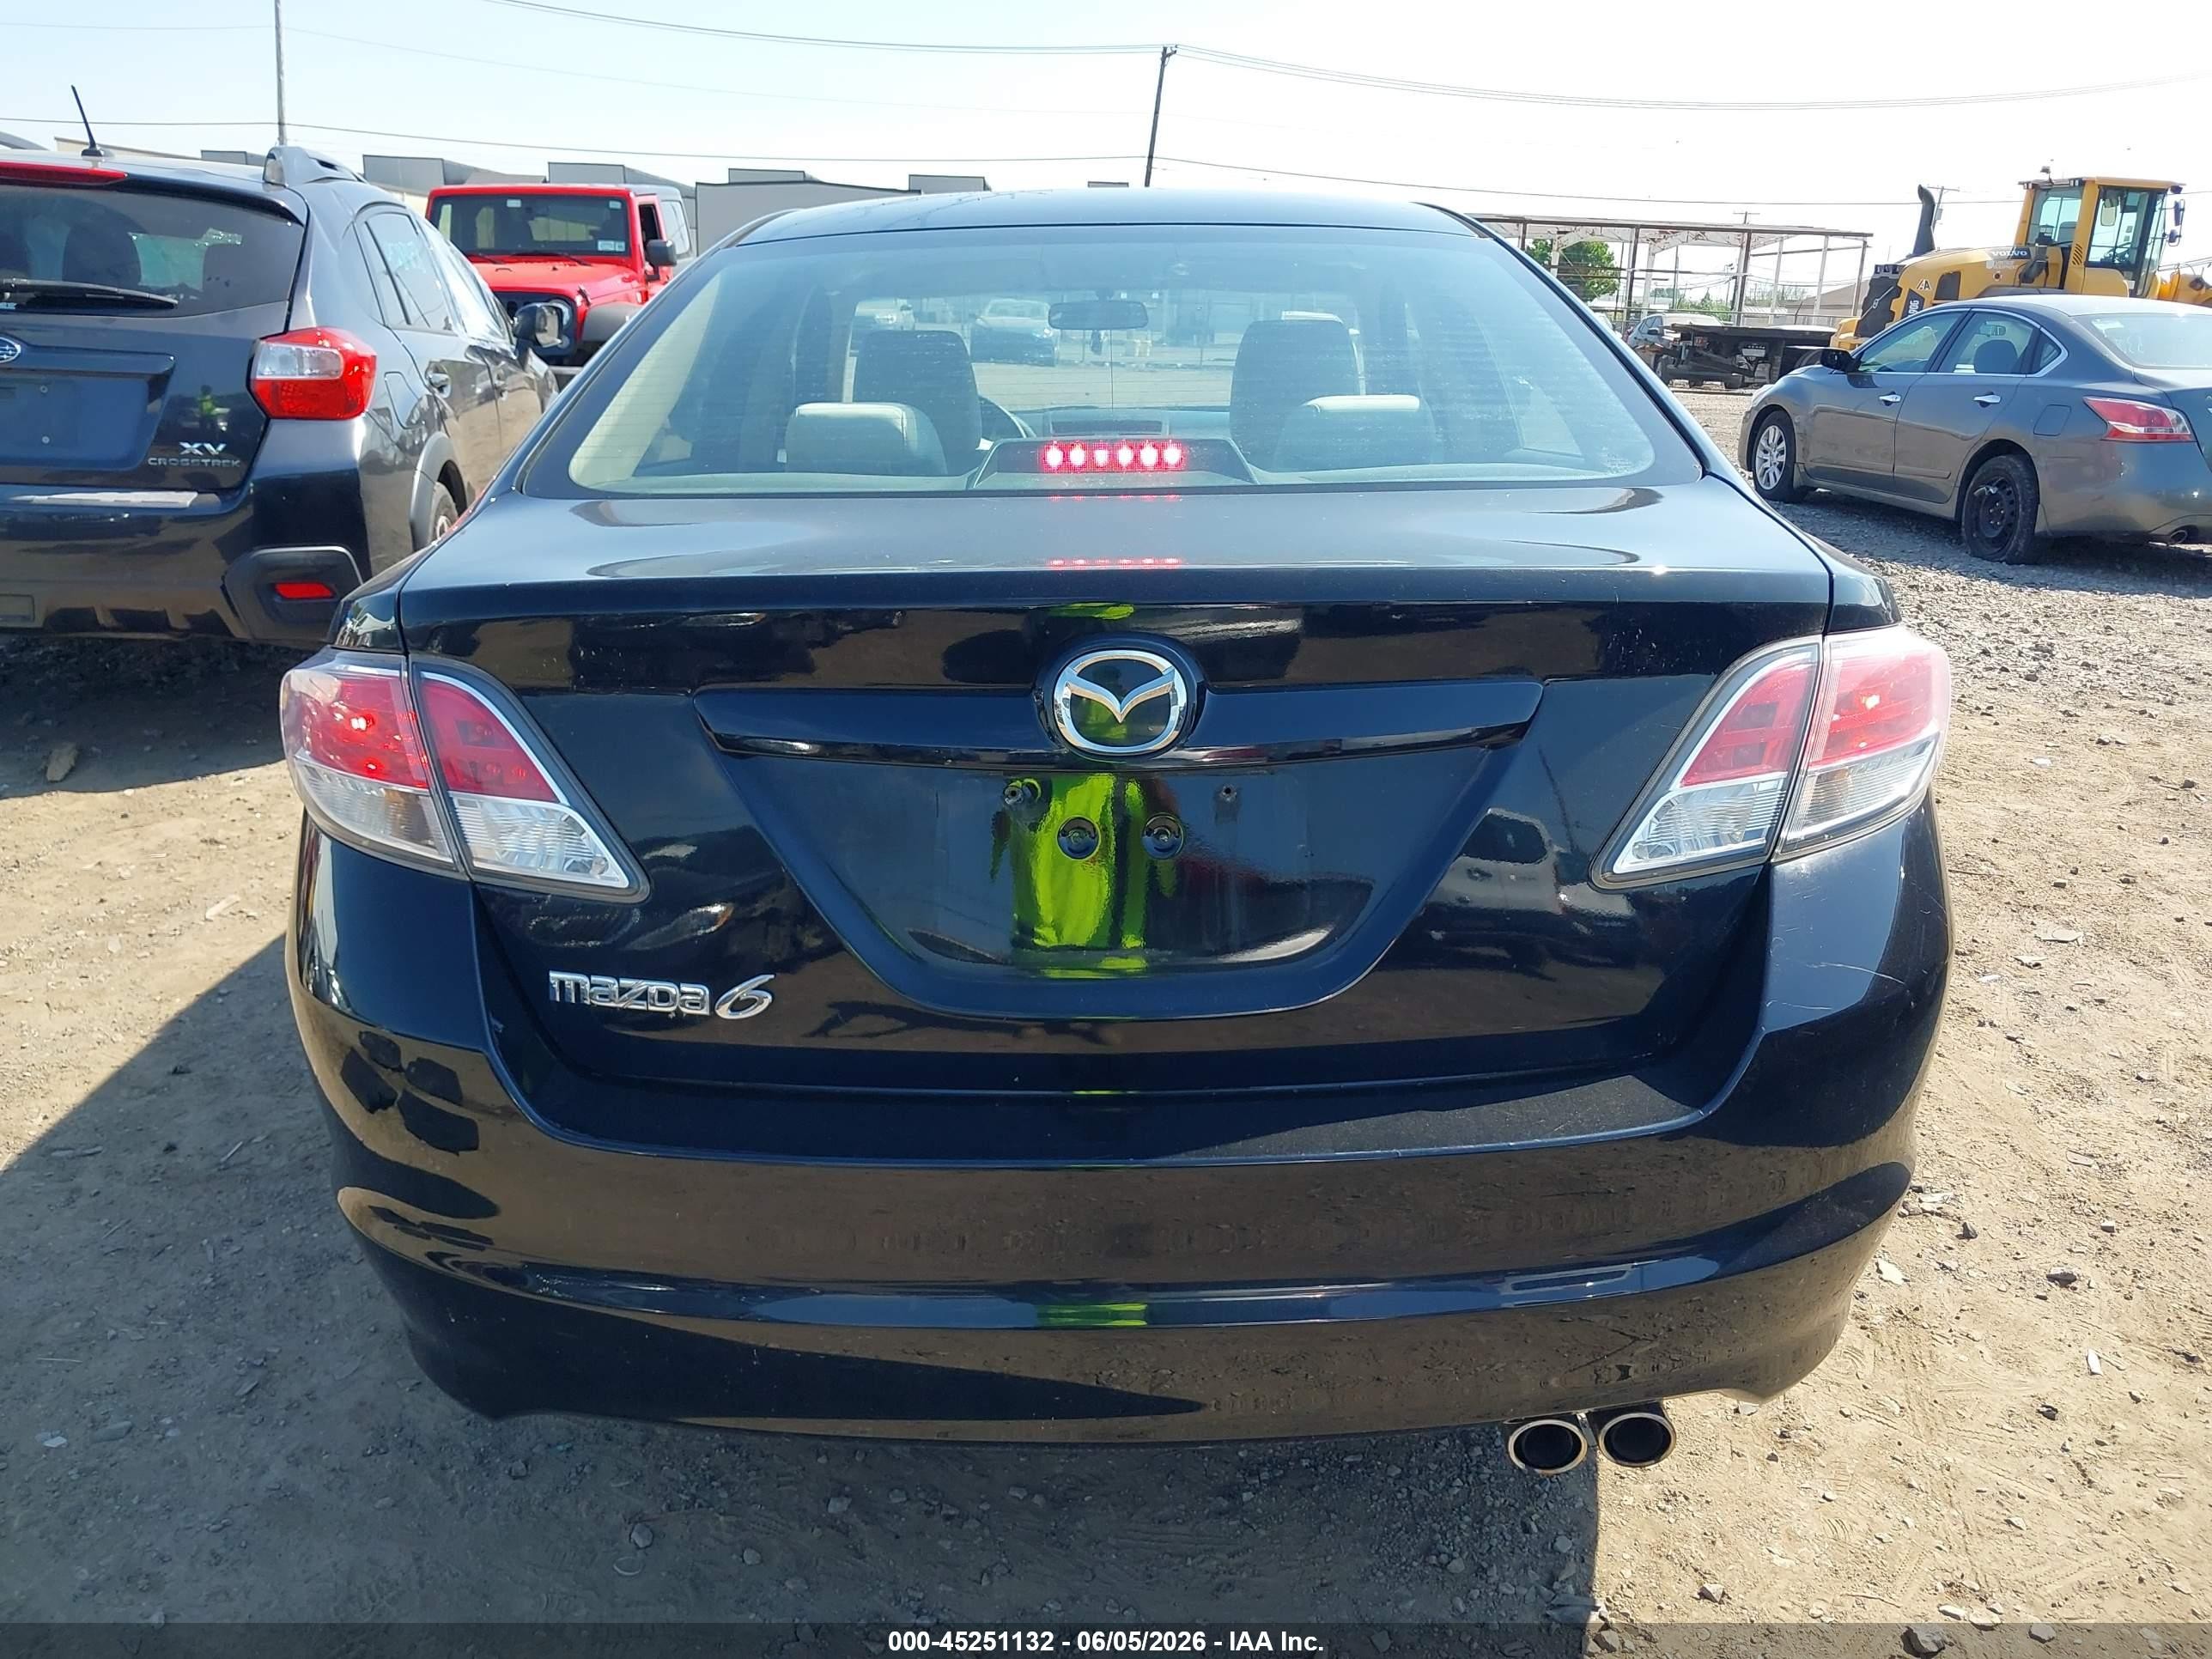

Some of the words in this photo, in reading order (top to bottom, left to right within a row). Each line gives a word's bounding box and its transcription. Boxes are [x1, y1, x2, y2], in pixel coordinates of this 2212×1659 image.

[1908, 300, 1920, 316] 90G
[179, 441, 227, 456] XV
[148, 457, 240, 467] CROSSTREK
